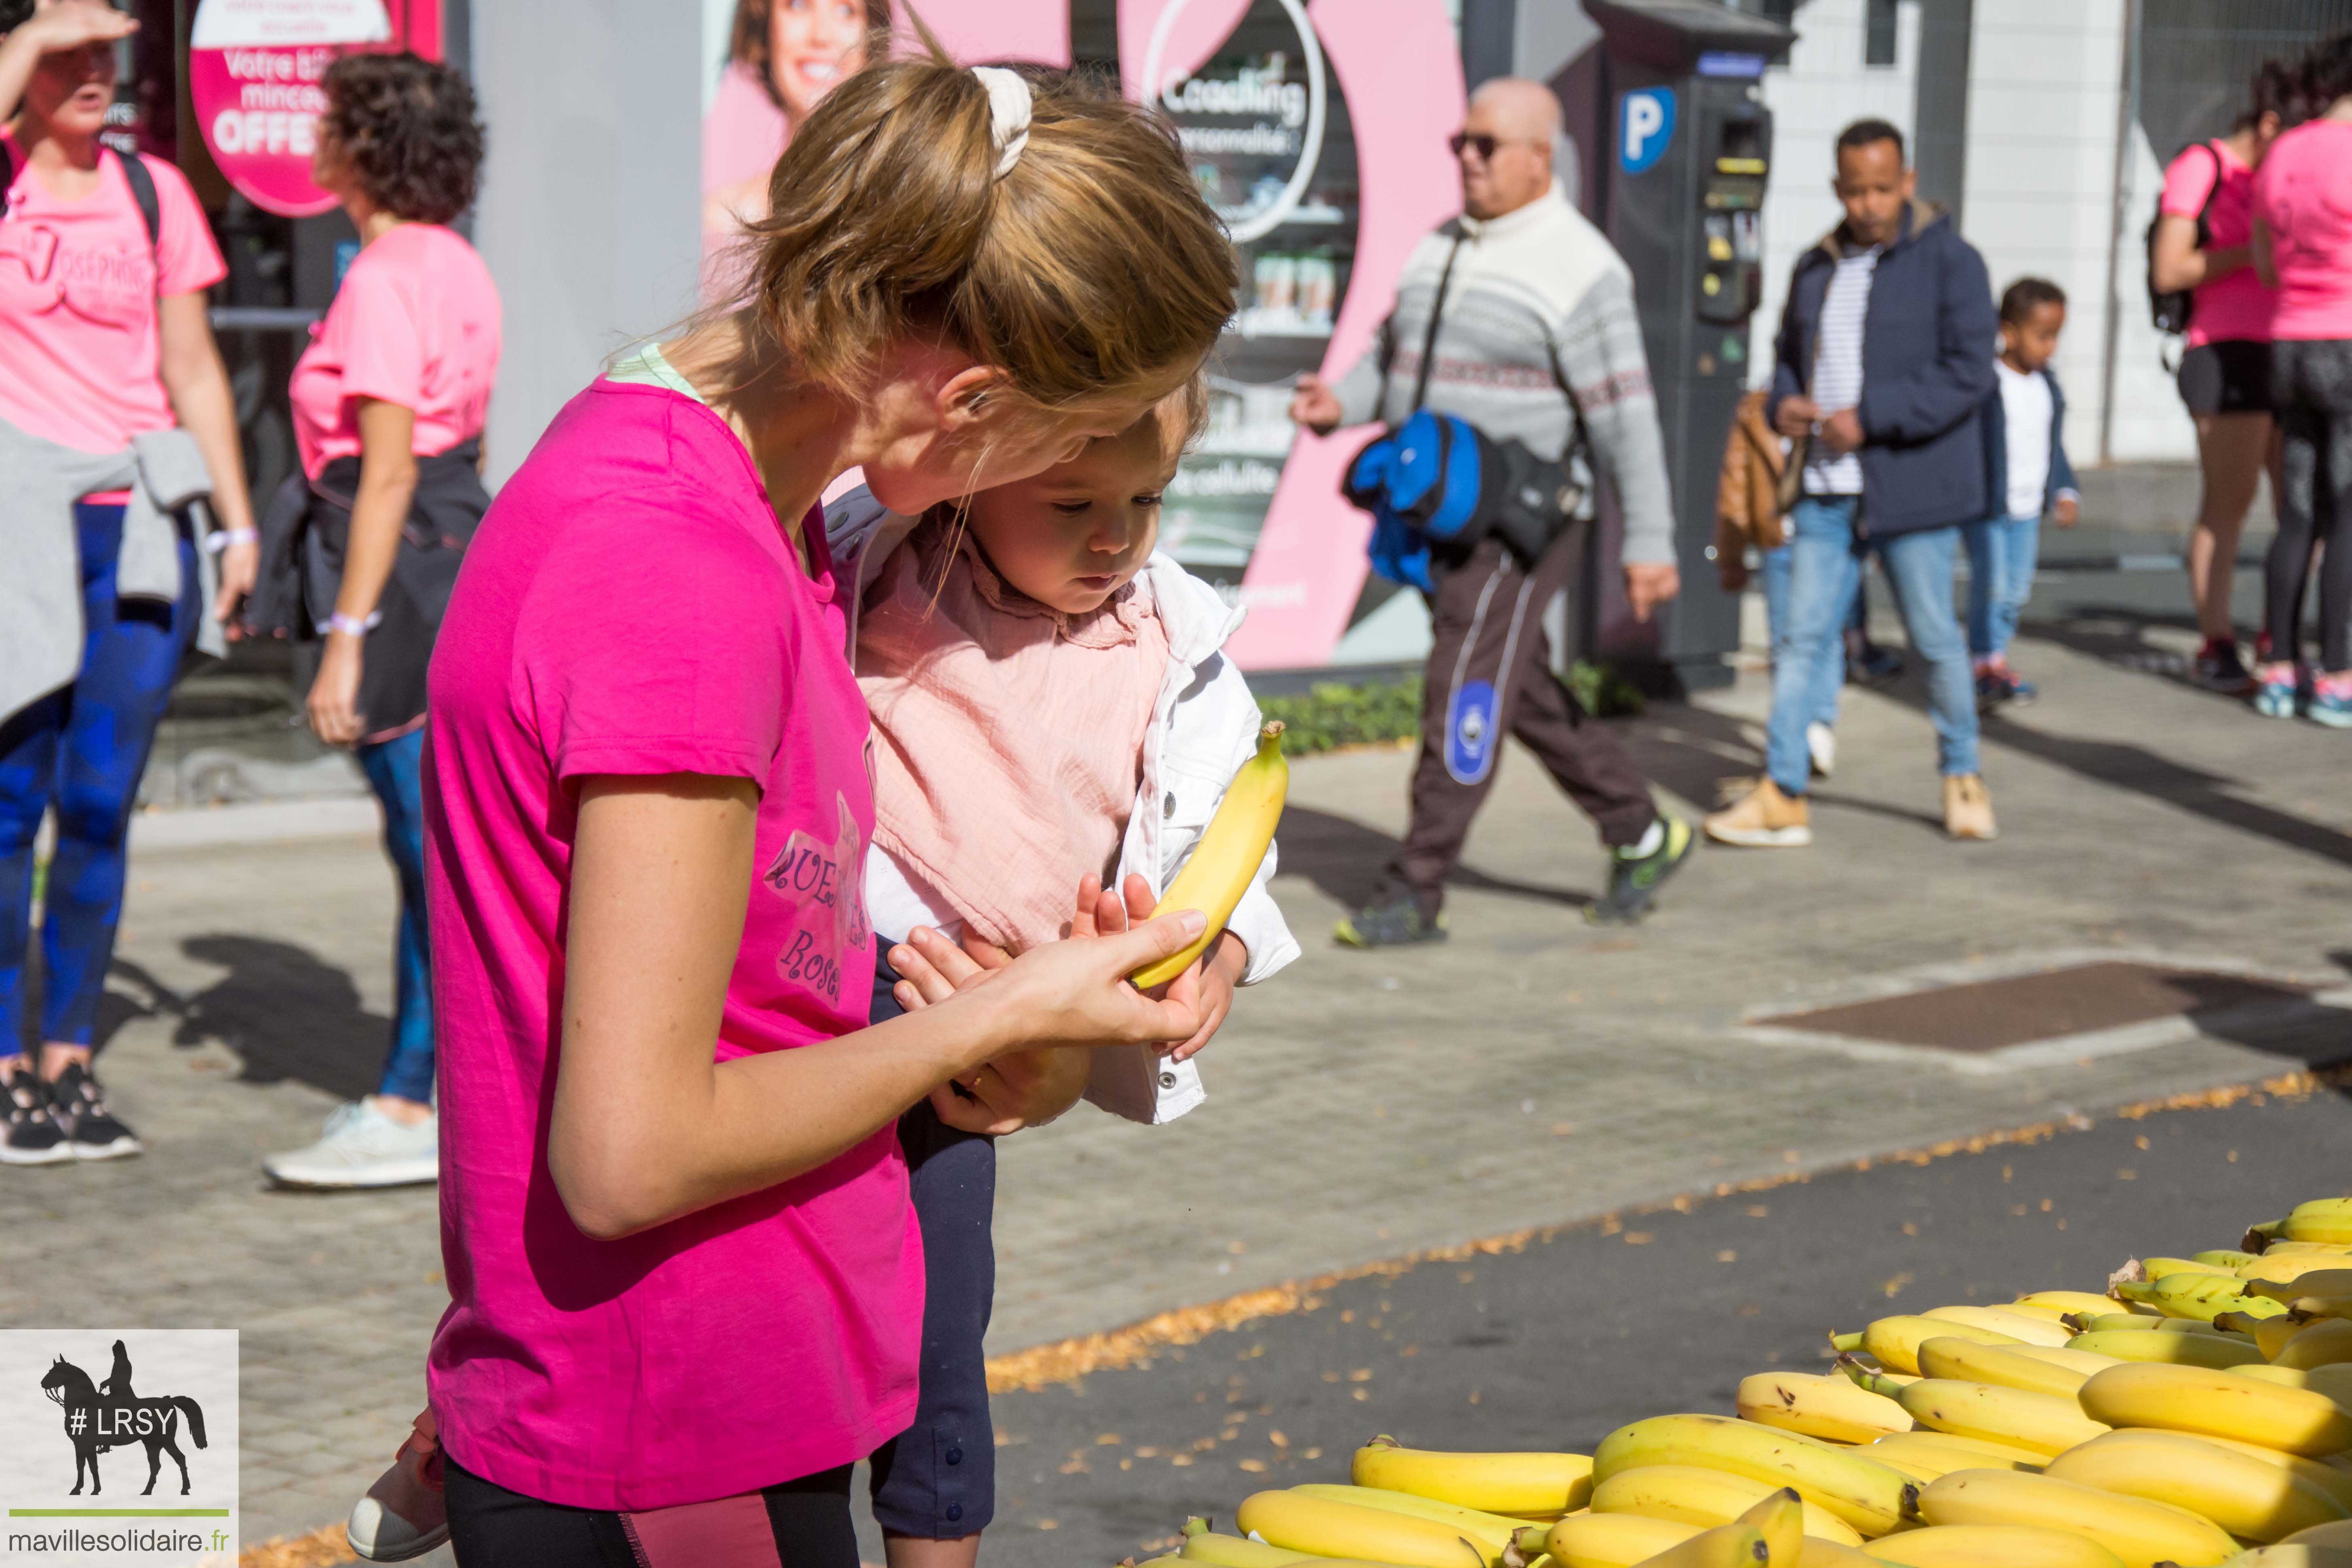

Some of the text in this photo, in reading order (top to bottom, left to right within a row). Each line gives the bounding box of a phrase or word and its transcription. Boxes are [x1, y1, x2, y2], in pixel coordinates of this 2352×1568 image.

[224, 48, 295, 80] Votre
[1162, 68, 1306, 127] Coaching
[213, 109, 318, 156] OFFE
[1625, 93, 1664, 161] P
